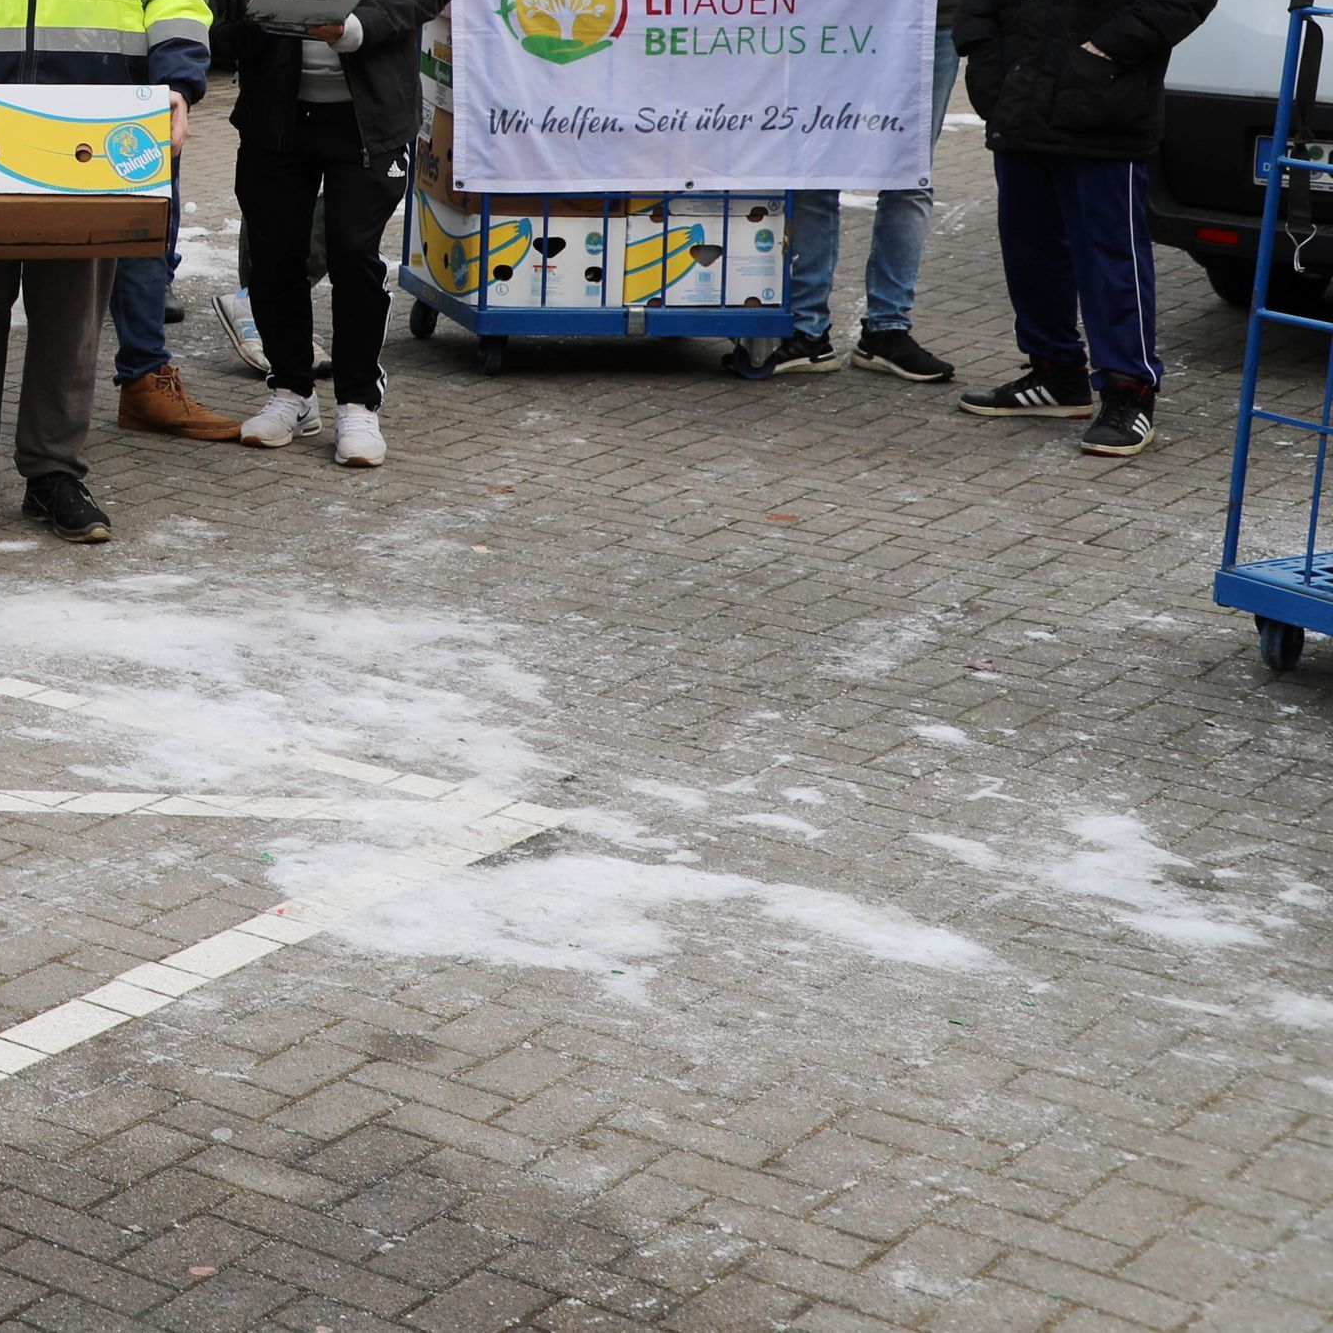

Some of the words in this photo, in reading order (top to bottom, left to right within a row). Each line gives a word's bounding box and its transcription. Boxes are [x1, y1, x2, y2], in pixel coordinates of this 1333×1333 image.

[645, 25, 806, 56] BELARUS
[820, 25, 877, 55] E.V.
[489, 107, 533, 135] Wir
[541, 105, 625, 140] helfen.
[635, 106, 689, 134] Seit
[695, 103, 754, 132] über
[760, 105, 799, 132] 25
[801, 102, 906, 134] Jahren.
[114, 145, 163, 178] Chiquita
[1262, 162, 1271, 172] D
